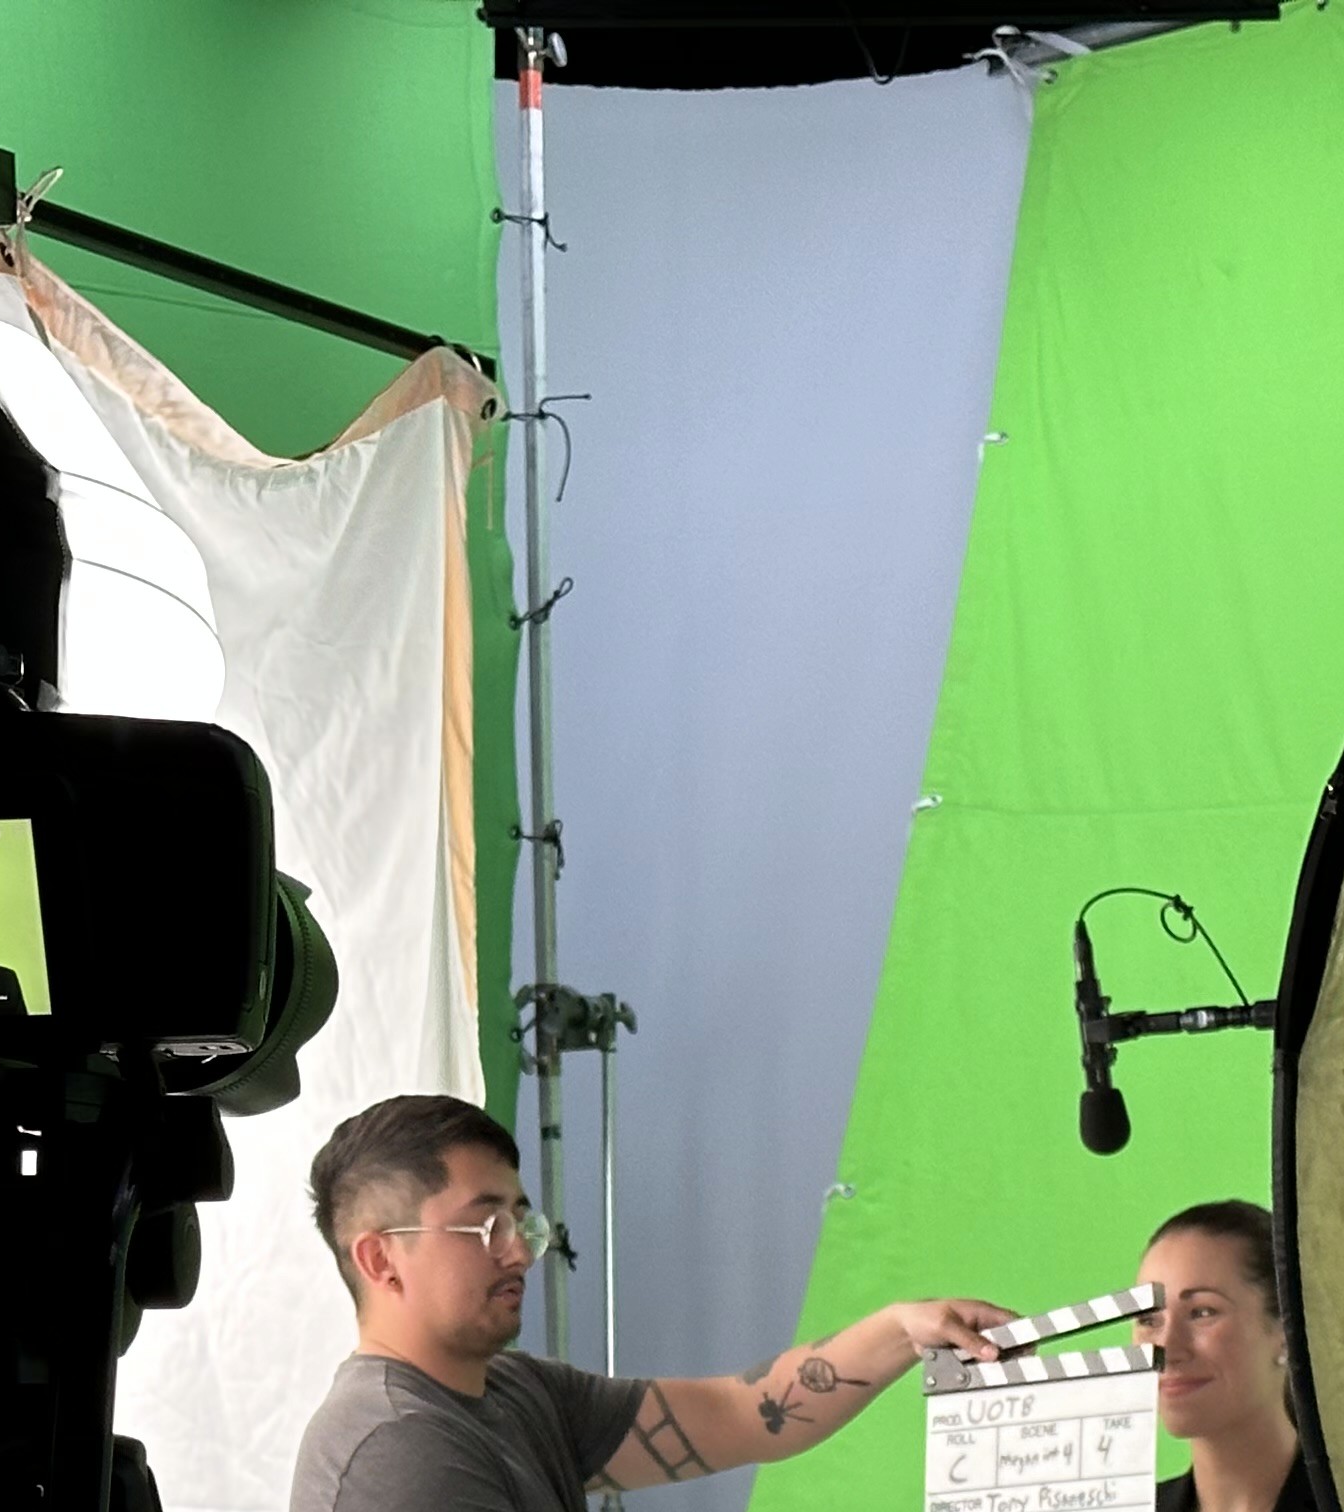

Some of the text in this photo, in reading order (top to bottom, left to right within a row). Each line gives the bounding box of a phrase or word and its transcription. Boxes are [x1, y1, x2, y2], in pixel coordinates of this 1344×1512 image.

[1104, 1416, 1132, 1430] TAKE
[1020, 1423, 1059, 1439] SCENE
[946, 1434, 976, 1447] ROLL
[1096, 1435, 1113, 1465] 4
